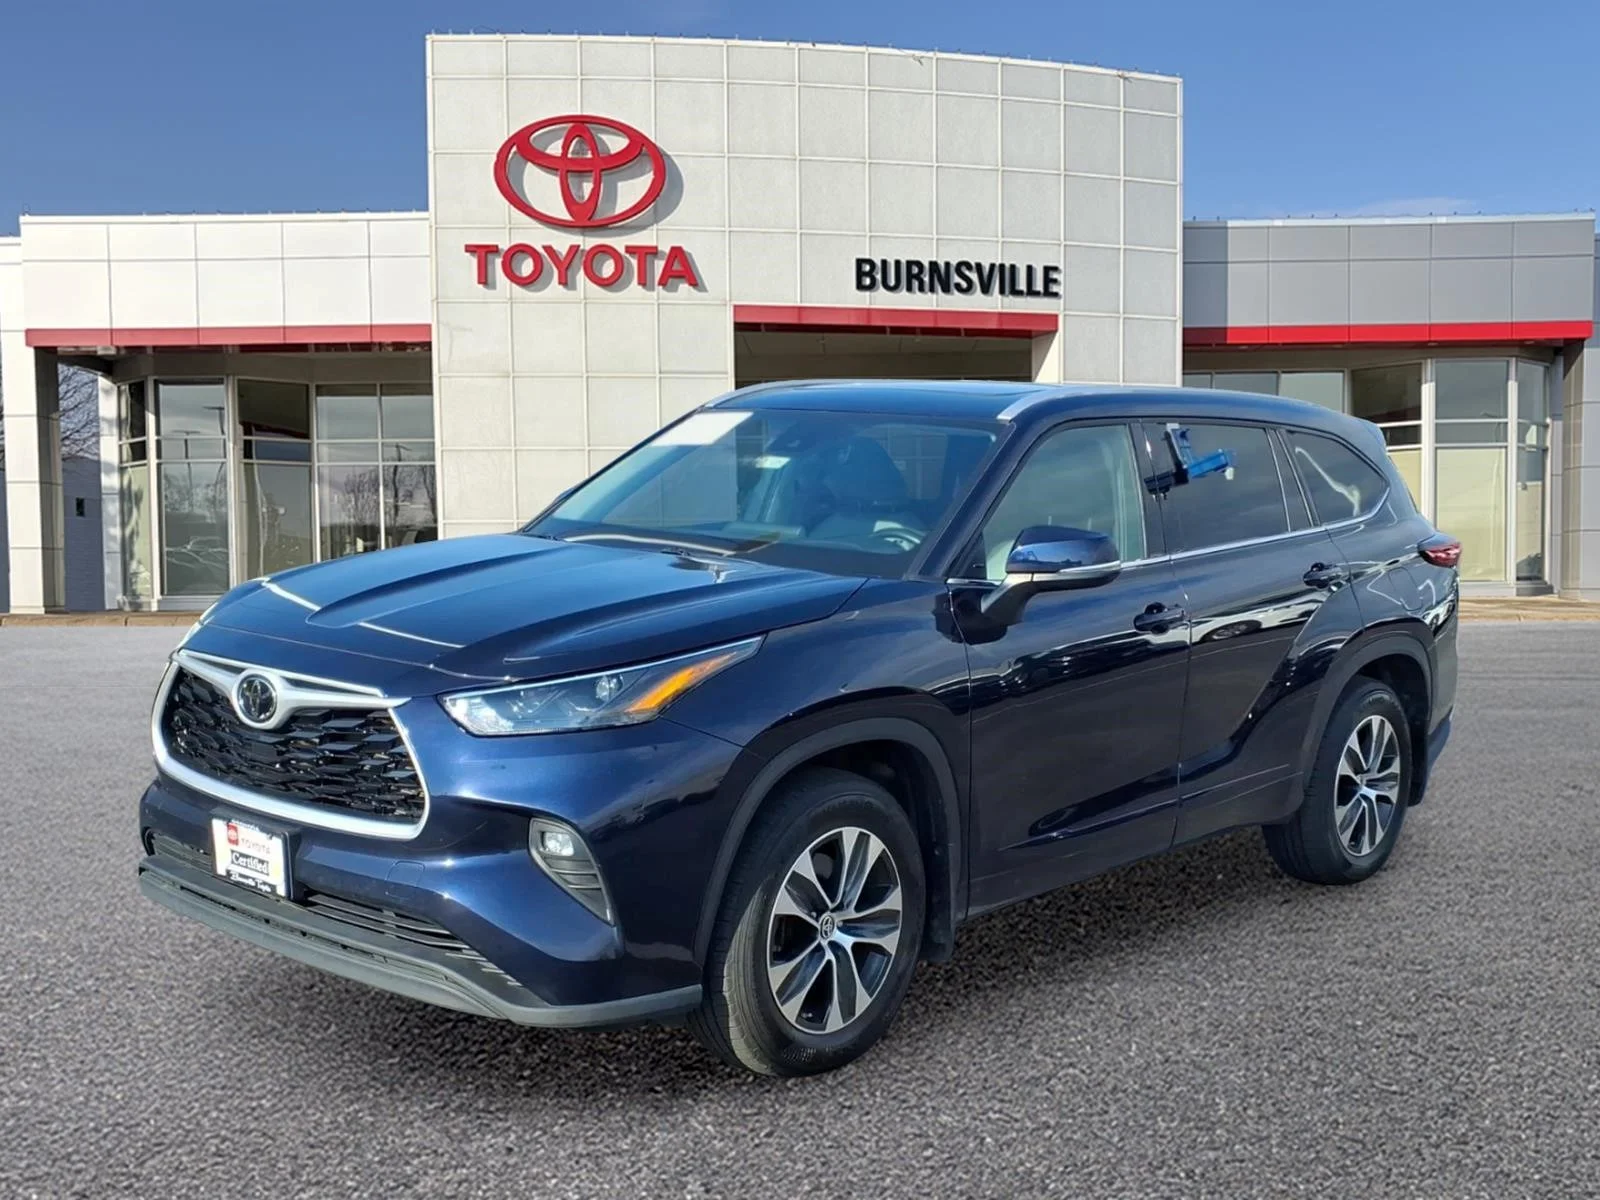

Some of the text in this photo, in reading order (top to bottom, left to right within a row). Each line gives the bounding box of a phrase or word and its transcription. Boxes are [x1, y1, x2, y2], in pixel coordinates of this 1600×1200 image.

[464, 243, 699, 287] TOYOTA
[855, 257, 1061, 298] BURNSVILLE
[241, 838, 271, 855] TOYOTA
[232, 852, 269, 875] Certified
